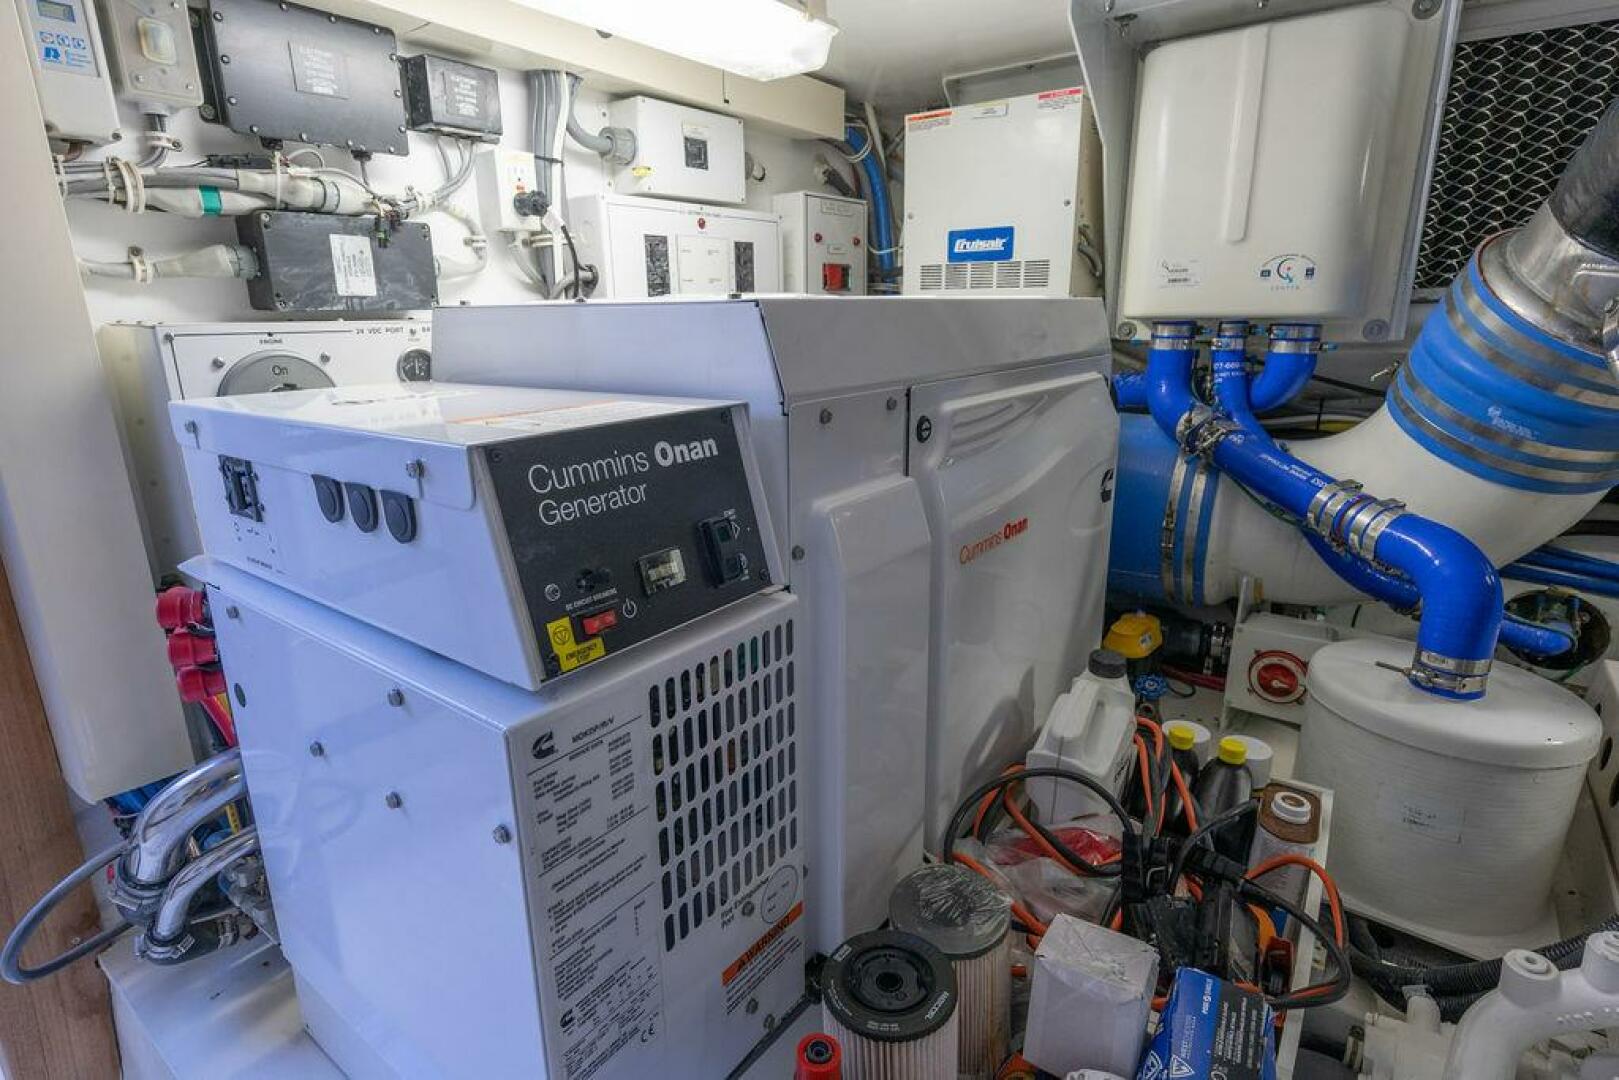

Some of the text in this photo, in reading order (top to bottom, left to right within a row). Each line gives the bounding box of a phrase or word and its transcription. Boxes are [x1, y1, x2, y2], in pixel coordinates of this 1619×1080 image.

[271, 364, 289, 376] On
[528, 437, 719, 494] Cummins Onan
[538, 483, 647, 526] Generator
[959, 517, 1029, 564] Cummins Onan
